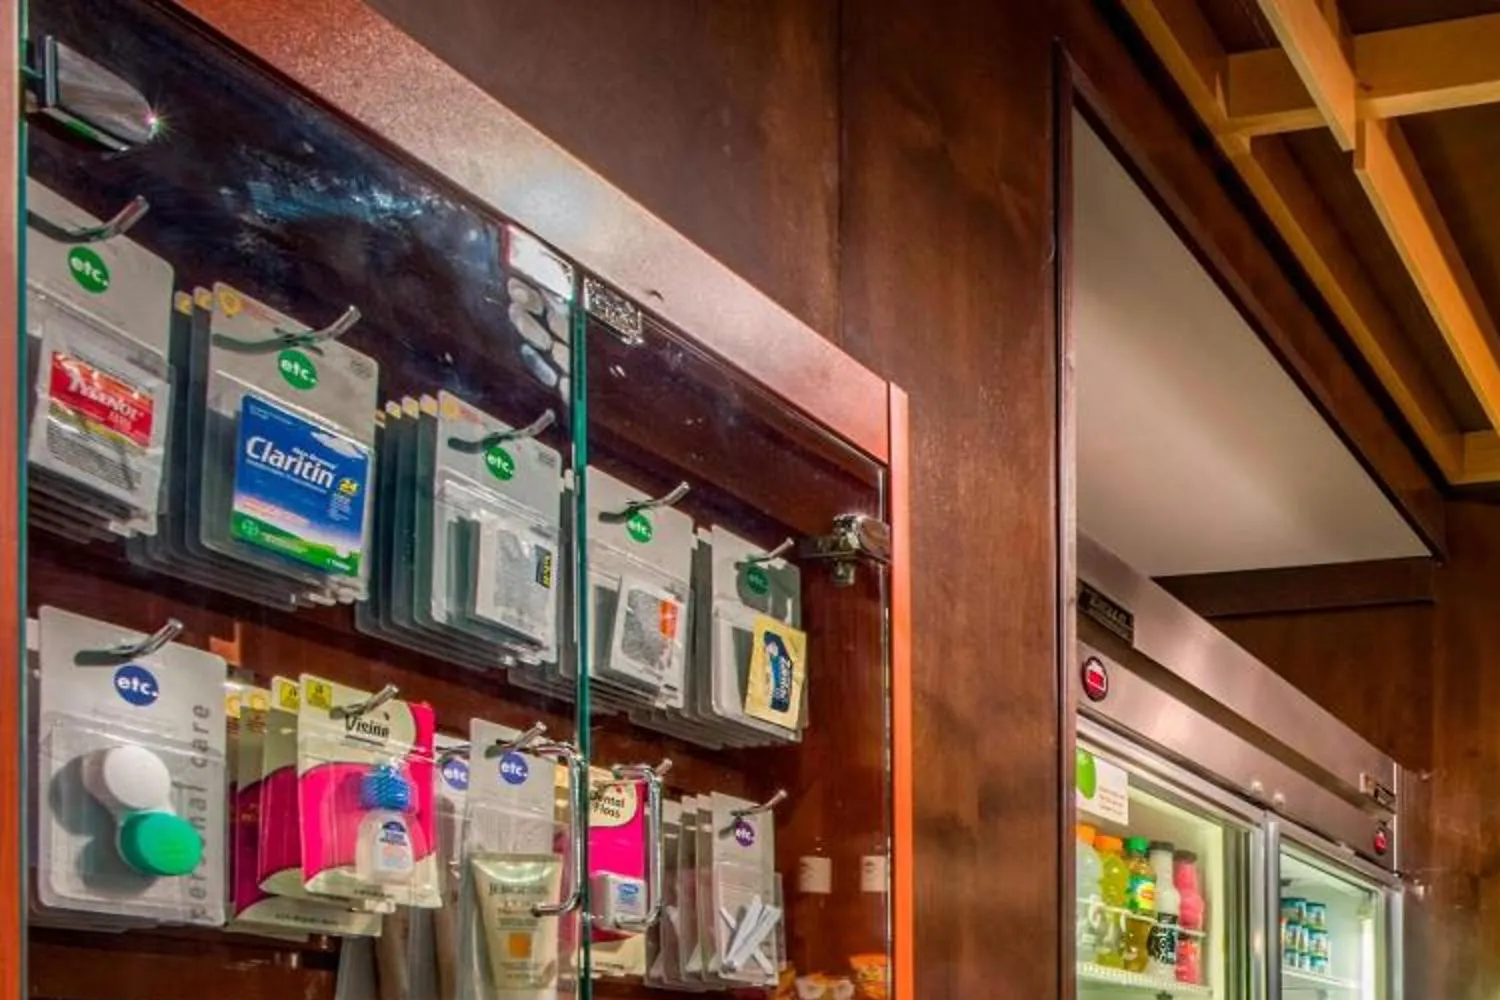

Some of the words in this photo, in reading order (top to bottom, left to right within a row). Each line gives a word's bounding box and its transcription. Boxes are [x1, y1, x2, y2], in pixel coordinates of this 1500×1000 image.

[69, 255, 109, 288] etc.
[280, 358, 317, 385] etc.
[246, 434, 336, 489] Claritin
[486, 450, 515, 475] etc.
[626, 519, 654, 539] etc.
[116, 672, 160, 699] etc.
[190, 703, 211, 768] care
[442, 763, 468, 782] etc
[499, 760, 529, 777] etc.
